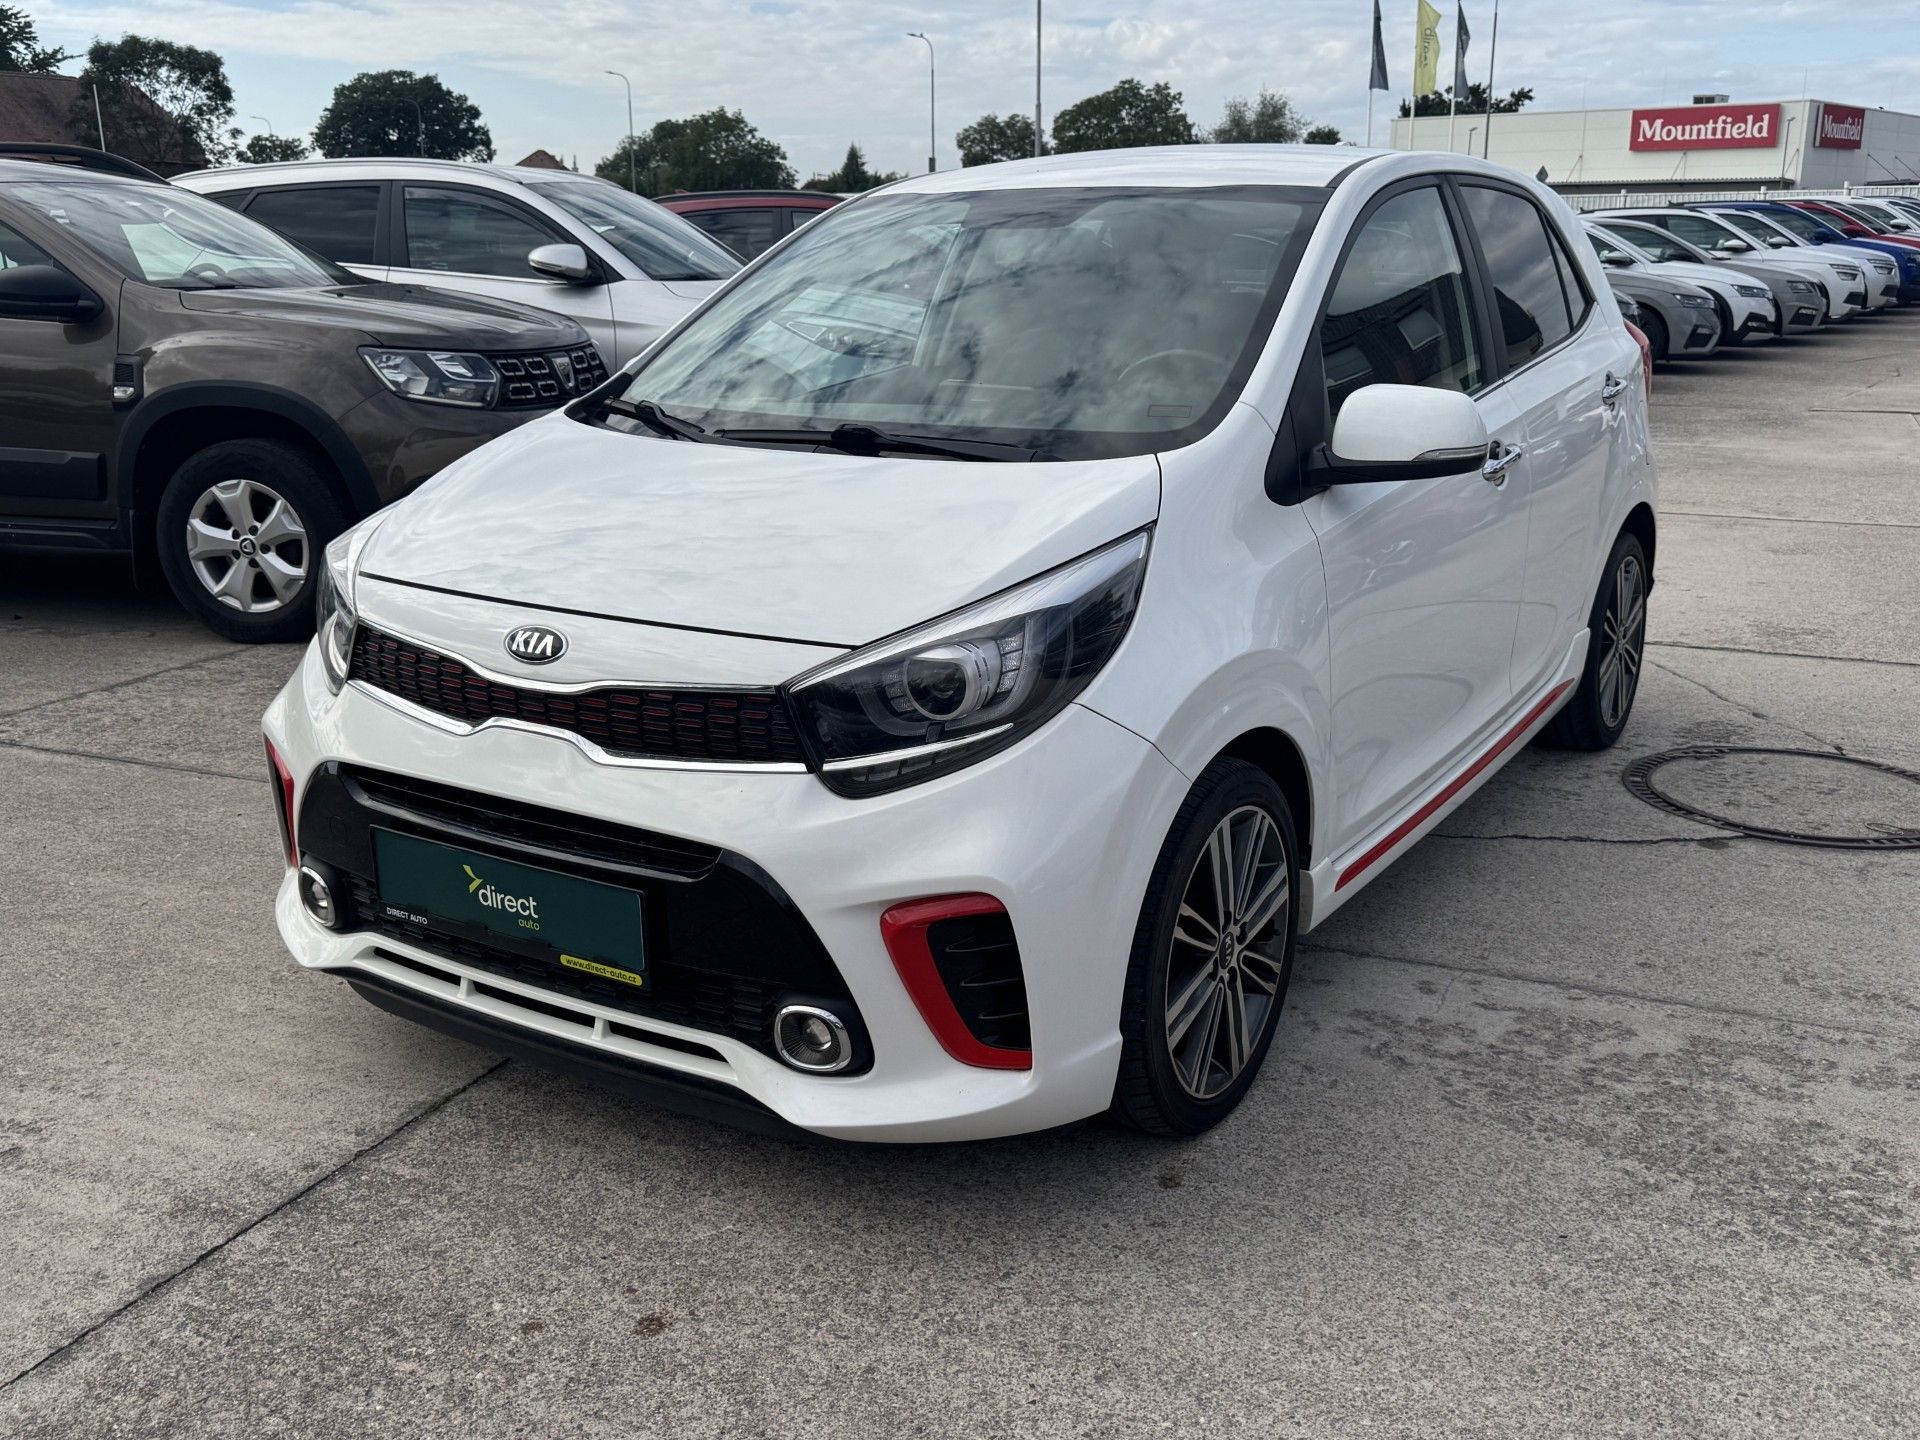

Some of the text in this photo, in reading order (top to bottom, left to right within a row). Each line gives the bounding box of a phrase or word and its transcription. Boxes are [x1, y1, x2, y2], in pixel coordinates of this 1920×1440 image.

[1637, 113, 1769, 142] Mountfield
[1822, 115, 1862, 140] Mountfield
[511, 630, 554, 656] KIA
[478, 885, 539, 918] direct
[386, 907, 428, 924] DIRECT AUTO
[518, 918, 540, 931] auto
[565, 957, 637, 983] www.direct-auto.cz
